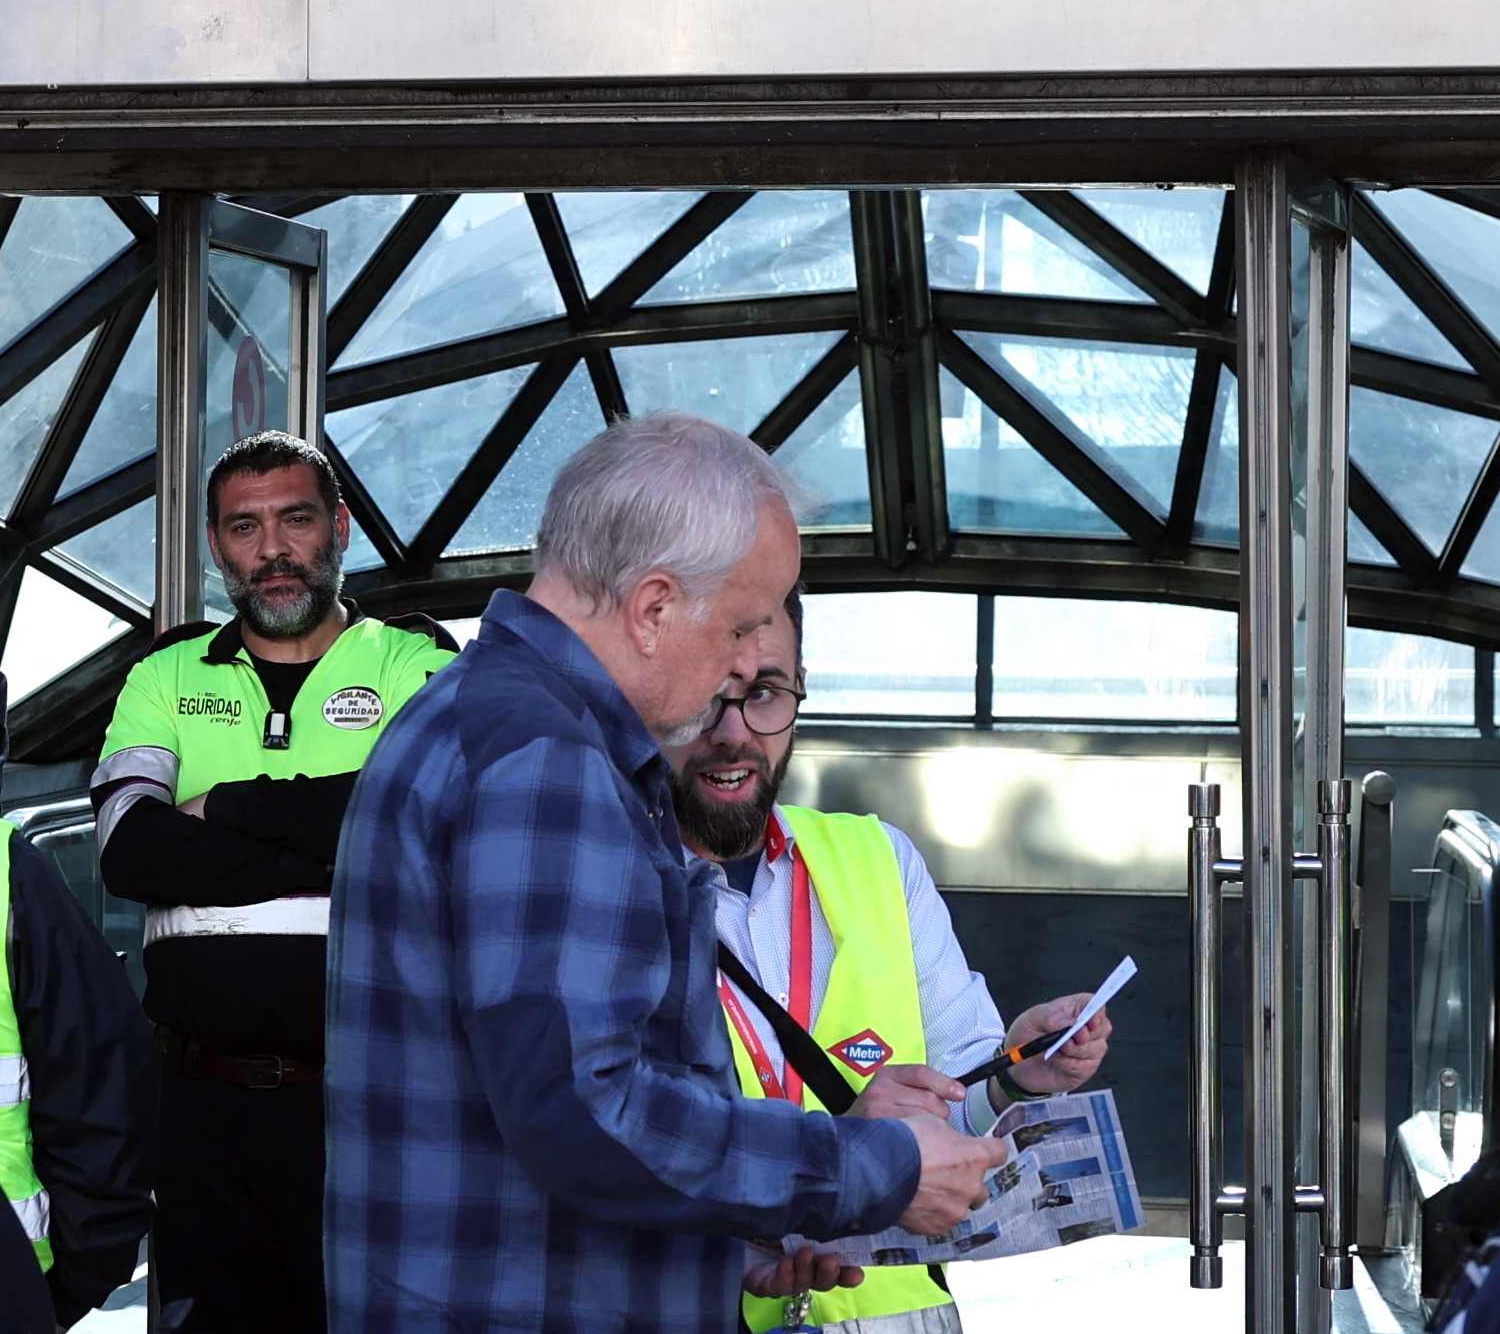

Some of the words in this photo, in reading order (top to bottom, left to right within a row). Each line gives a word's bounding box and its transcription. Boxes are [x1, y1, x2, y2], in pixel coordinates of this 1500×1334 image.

[330, 690, 378, 707] VIGILANTE
[347, 699, 360, 708] DE
[177, 697, 242, 717] EGURIDAD
[324, 707, 381, 717] SEGURIDAD
[208, 715, 243, 727] renfe
[849, 1046, 882, 1060] Metro
